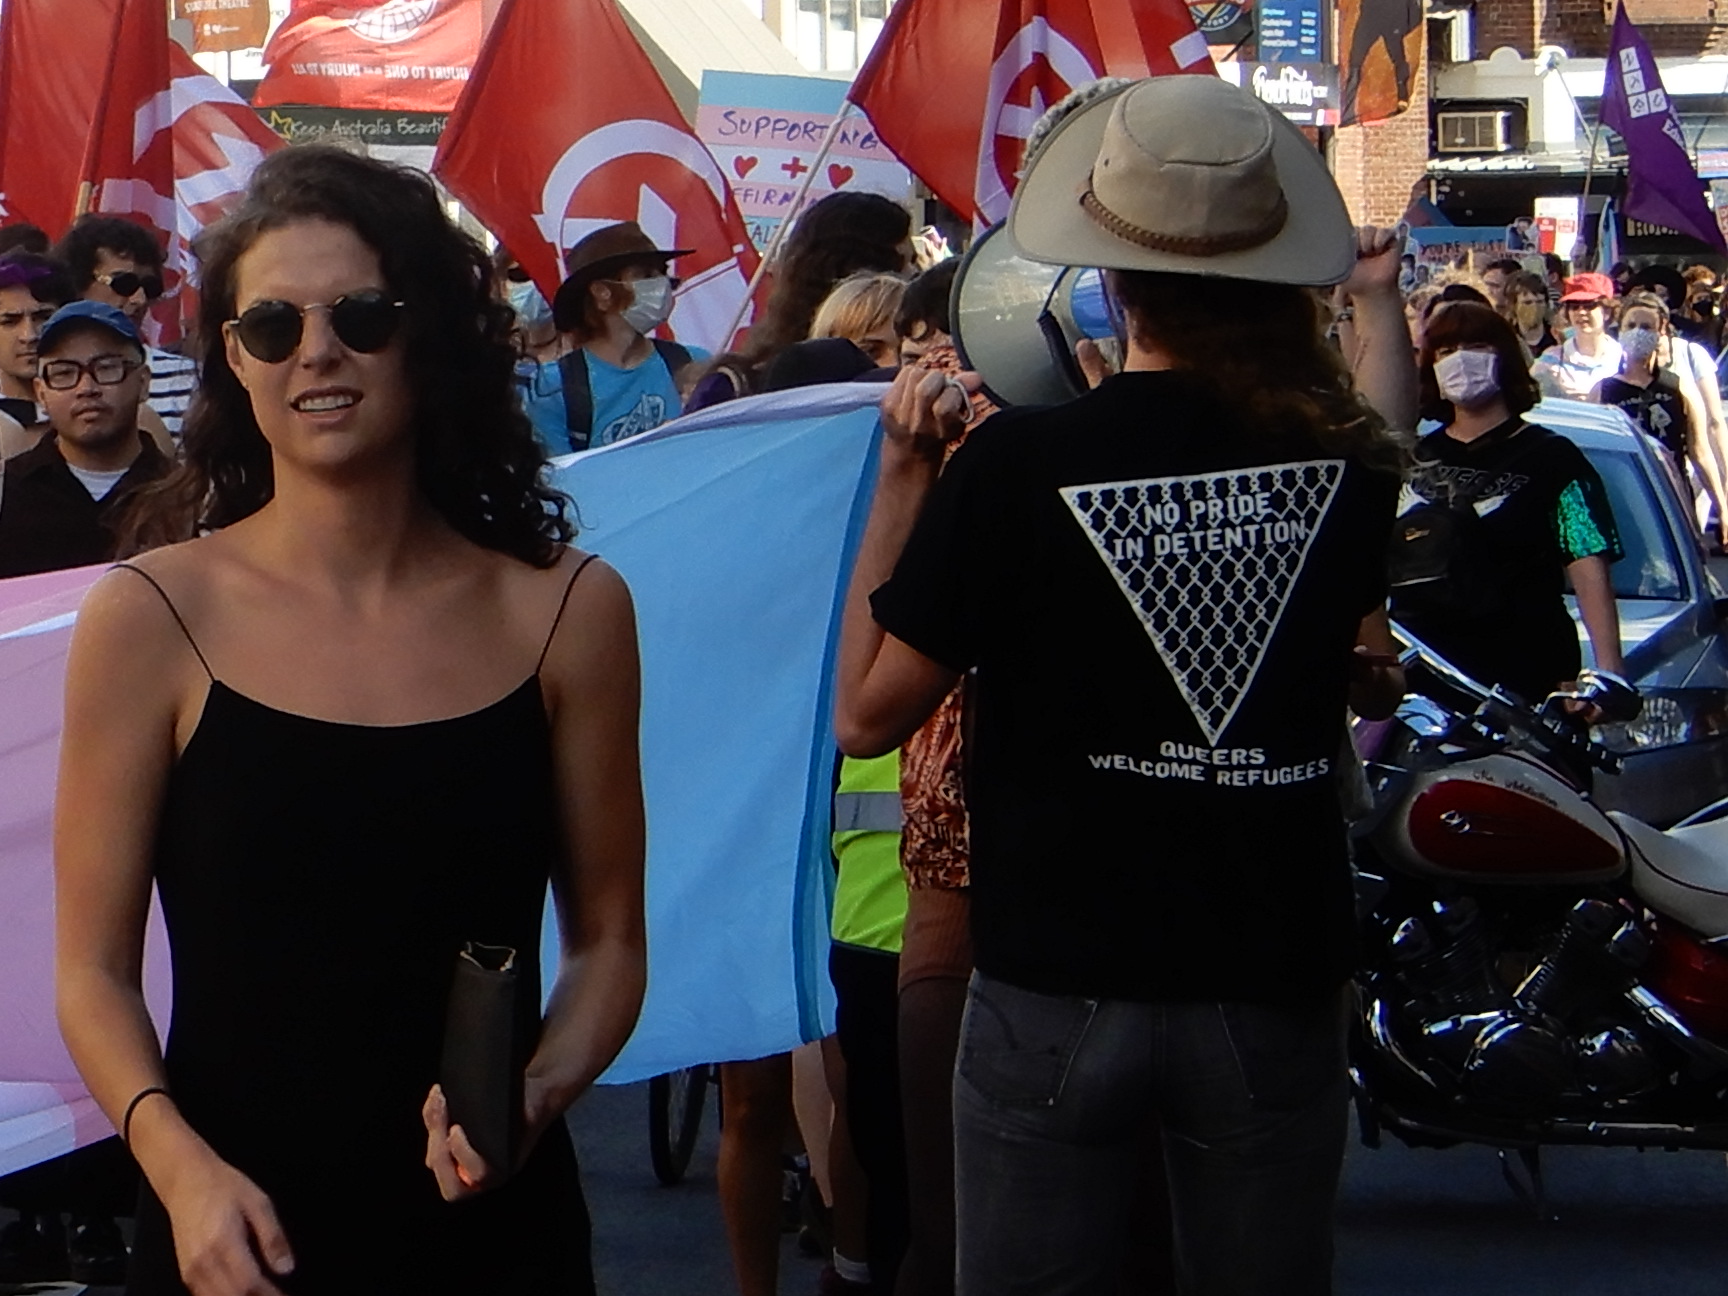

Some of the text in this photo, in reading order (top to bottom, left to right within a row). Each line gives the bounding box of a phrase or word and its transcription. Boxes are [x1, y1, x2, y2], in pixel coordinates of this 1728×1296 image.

[331, 118, 392, 136] Australia
[397, 116, 449, 136] Beautif
[717, 110, 879, 151] SUPPORTNG
[1144, 491, 1272, 527] NO PRIDE
[1112, 518, 1307, 561] IN DETENTION
[1088, 753, 1329, 787] WELCOME REFUGEES
[1159, 740, 1266, 766] QUEERS
